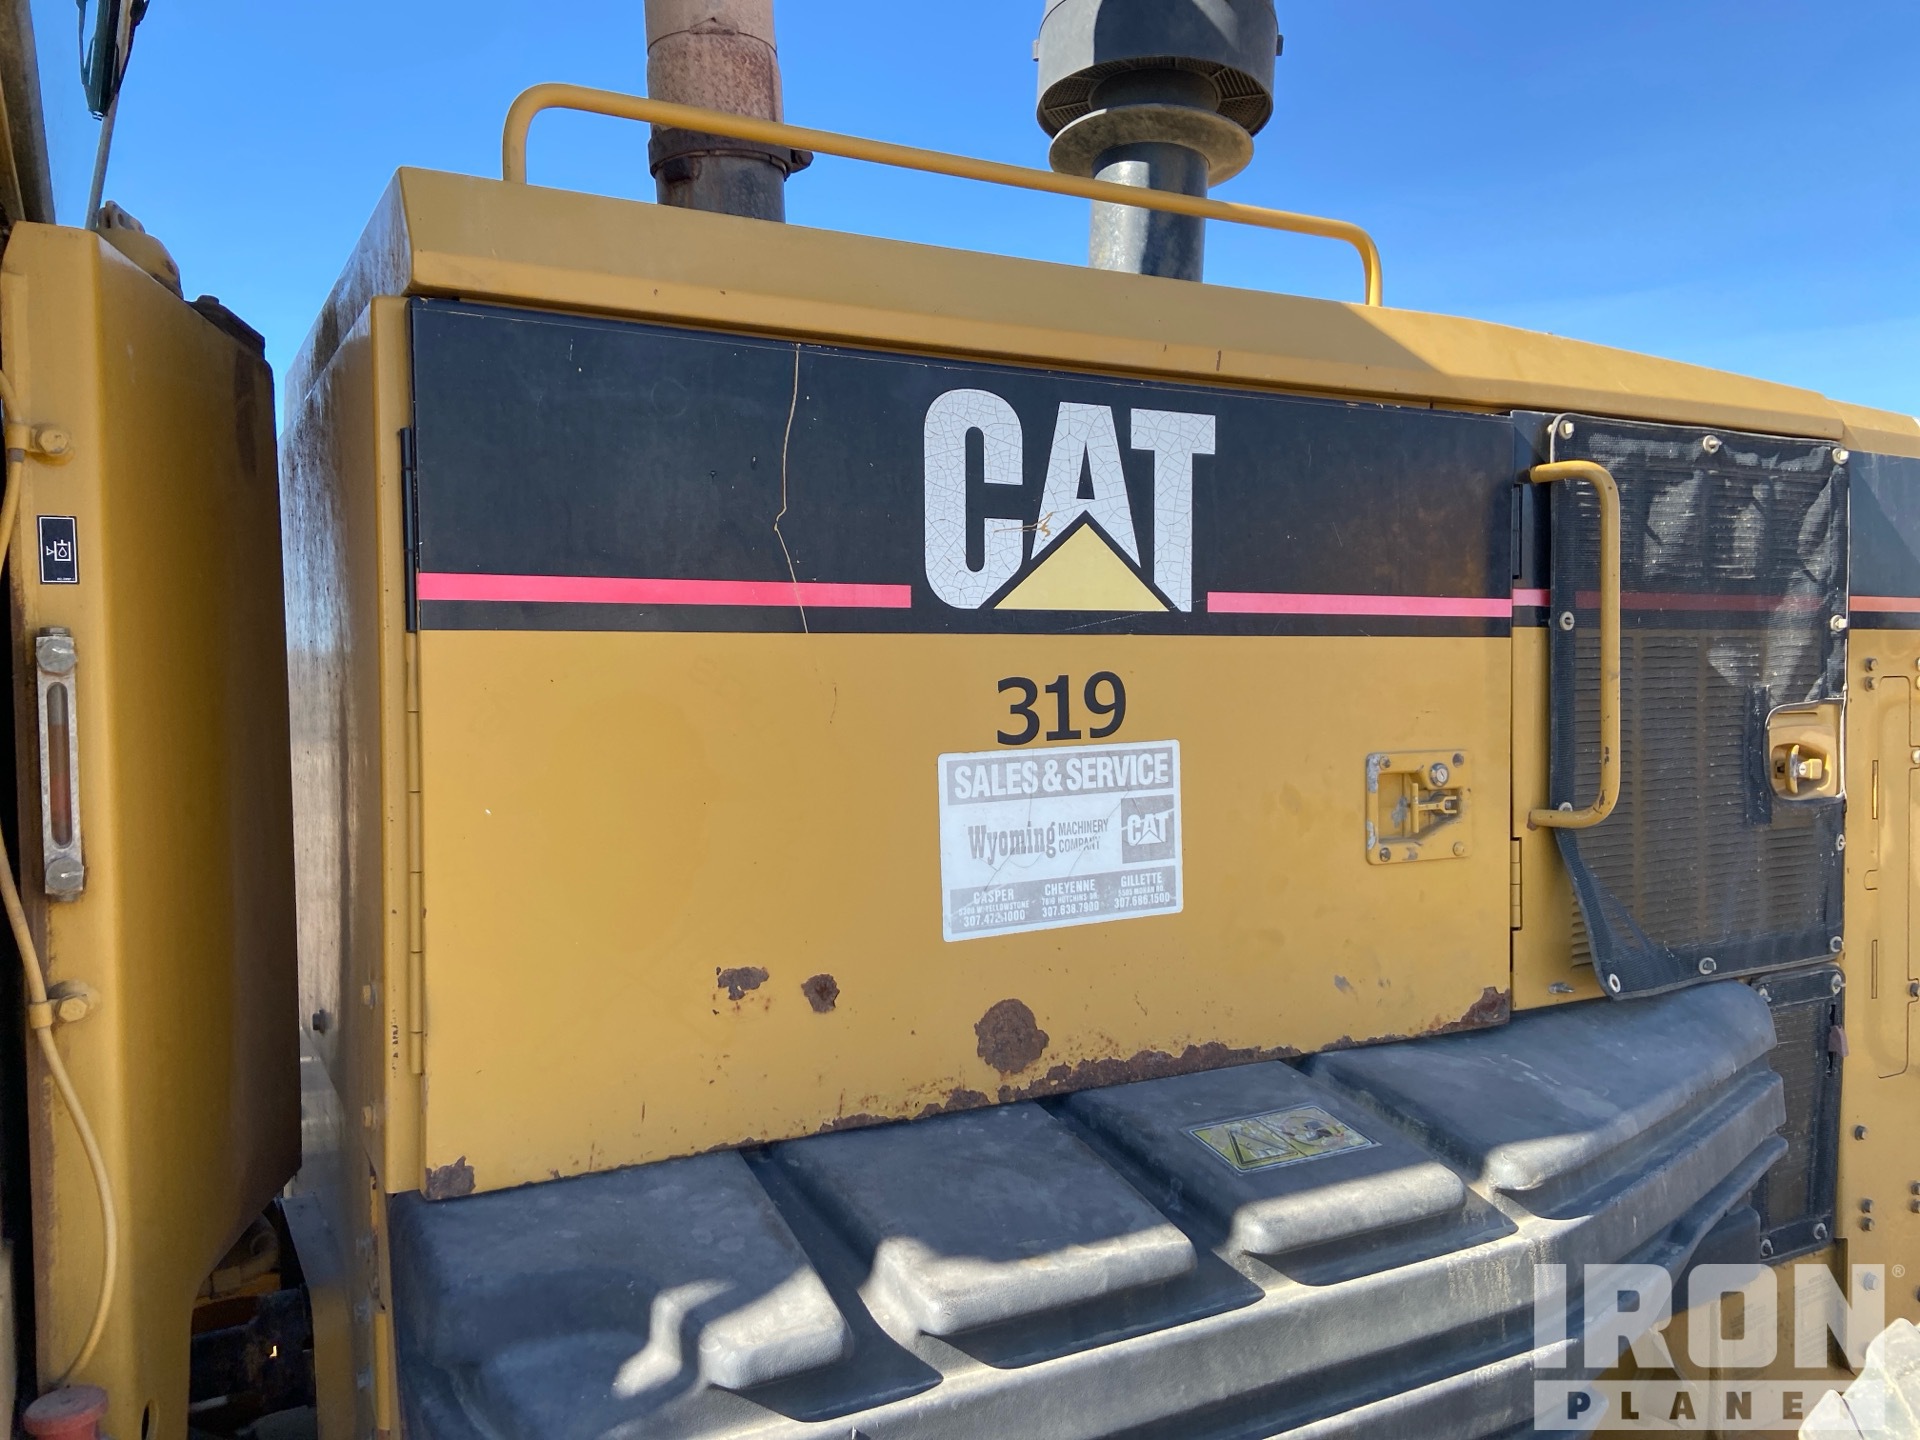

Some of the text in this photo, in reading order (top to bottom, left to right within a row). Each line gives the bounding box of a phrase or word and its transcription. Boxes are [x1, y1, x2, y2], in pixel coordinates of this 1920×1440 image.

[924, 389, 1215, 612] CAT
[997, 671, 1126, 745] 319
[954, 752, 1169, 799] SALES & SERVICE
[1058, 818, 1109, 836] MACHINERY
[1126, 812, 1170, 846] CAT
[968, 821, 1056, 865] Wyoming
[1059, 836, 1101, 853] COMPANY
[1044, 879, 1096, 896] CHEYENNE
[1120, 872, 1163, 888] GILLETTE
[973, 888, 1015, 905] CASPER
[1114, 892, 1171, 909] 307.686.1500
[986, 900, 1030, 913] YELLOWSTONE
[1042, 900, 1100, 918] 307.638.7900
[963, 909, 1026, 928] 307.472.1000
